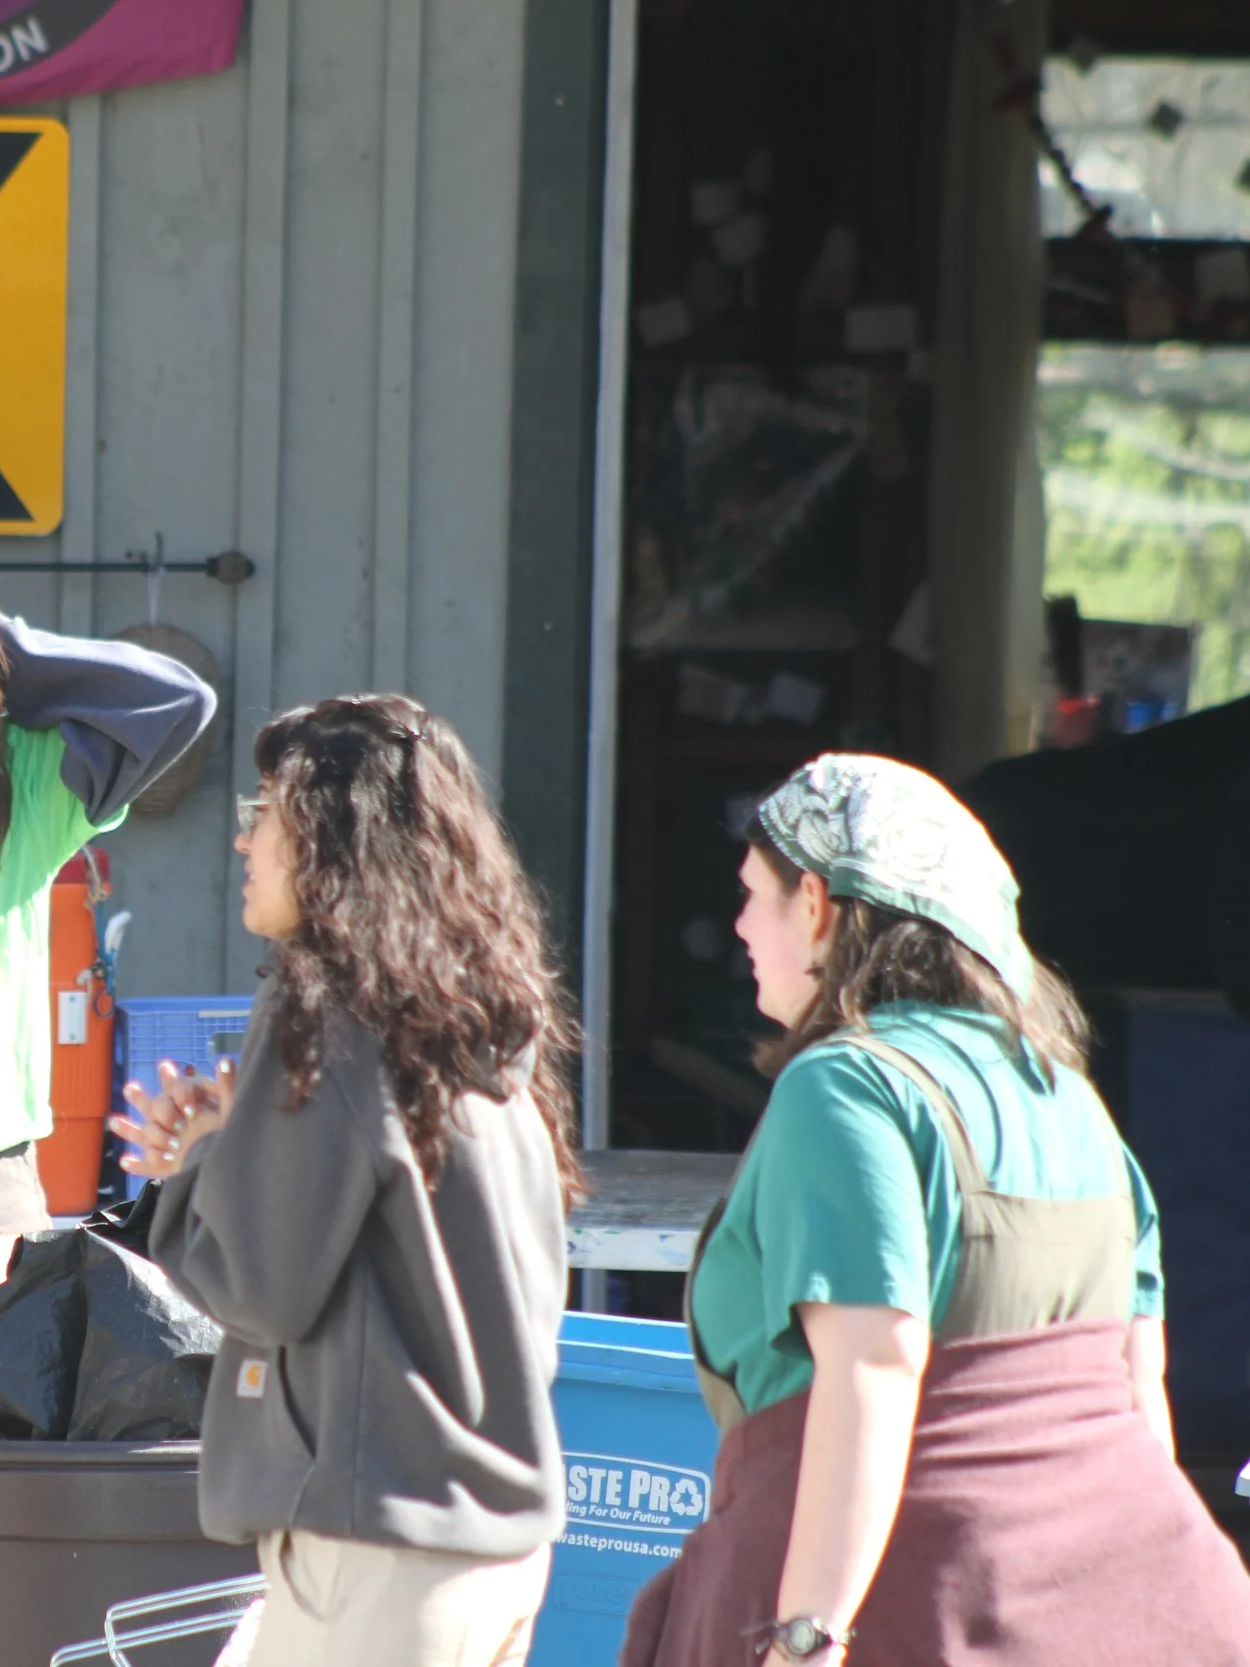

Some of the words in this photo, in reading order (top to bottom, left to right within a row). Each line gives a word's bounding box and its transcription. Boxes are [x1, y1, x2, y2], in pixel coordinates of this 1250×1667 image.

[567, 1465, 623, 1506] STE
[589, 1504, 608, 1517] For
[610, 1507, 631, 1521] Our
[632, 1510, 671, 1526] Future
